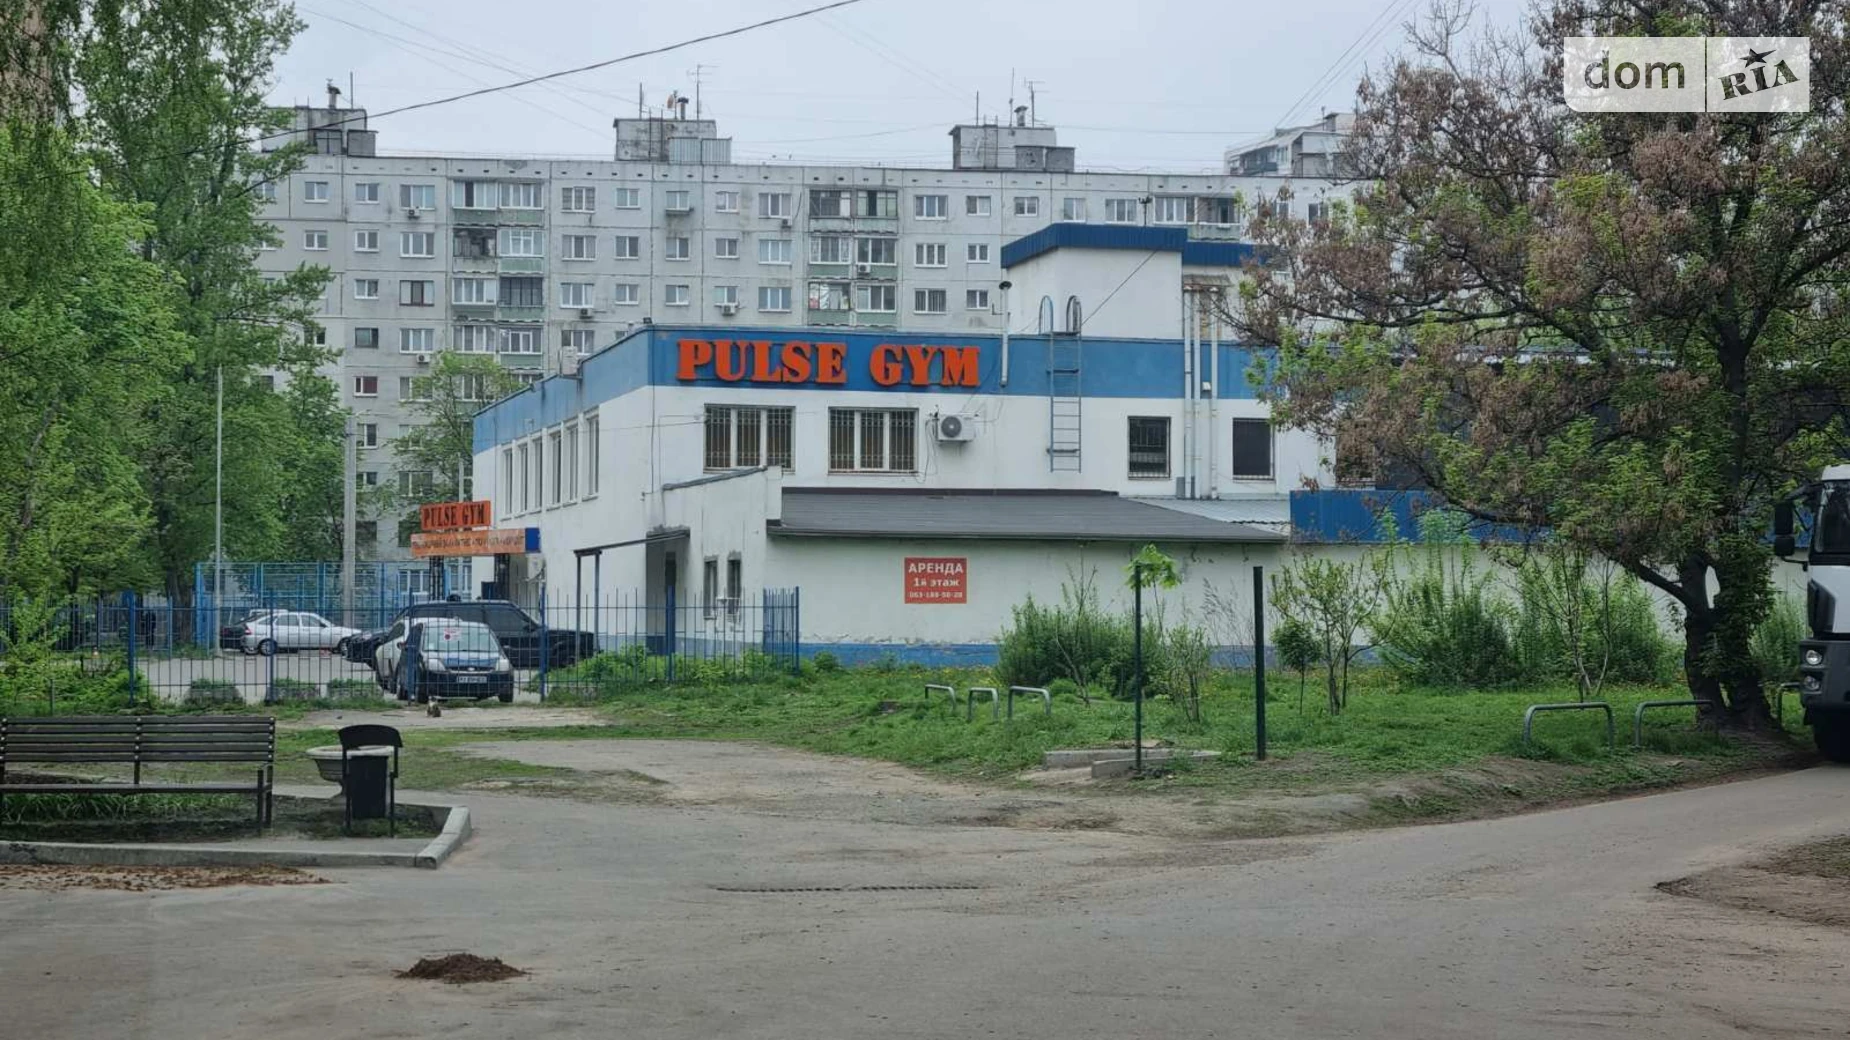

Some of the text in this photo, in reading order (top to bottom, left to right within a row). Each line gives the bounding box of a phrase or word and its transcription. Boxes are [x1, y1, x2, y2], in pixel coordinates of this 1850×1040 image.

[676, 338, 981, 386] PULSE GYM
[423, 503, 485, 528] PULSE GYM
[908, 562, 964, 576] АРЕНДА
[930, 579, 960, 587] этаж
